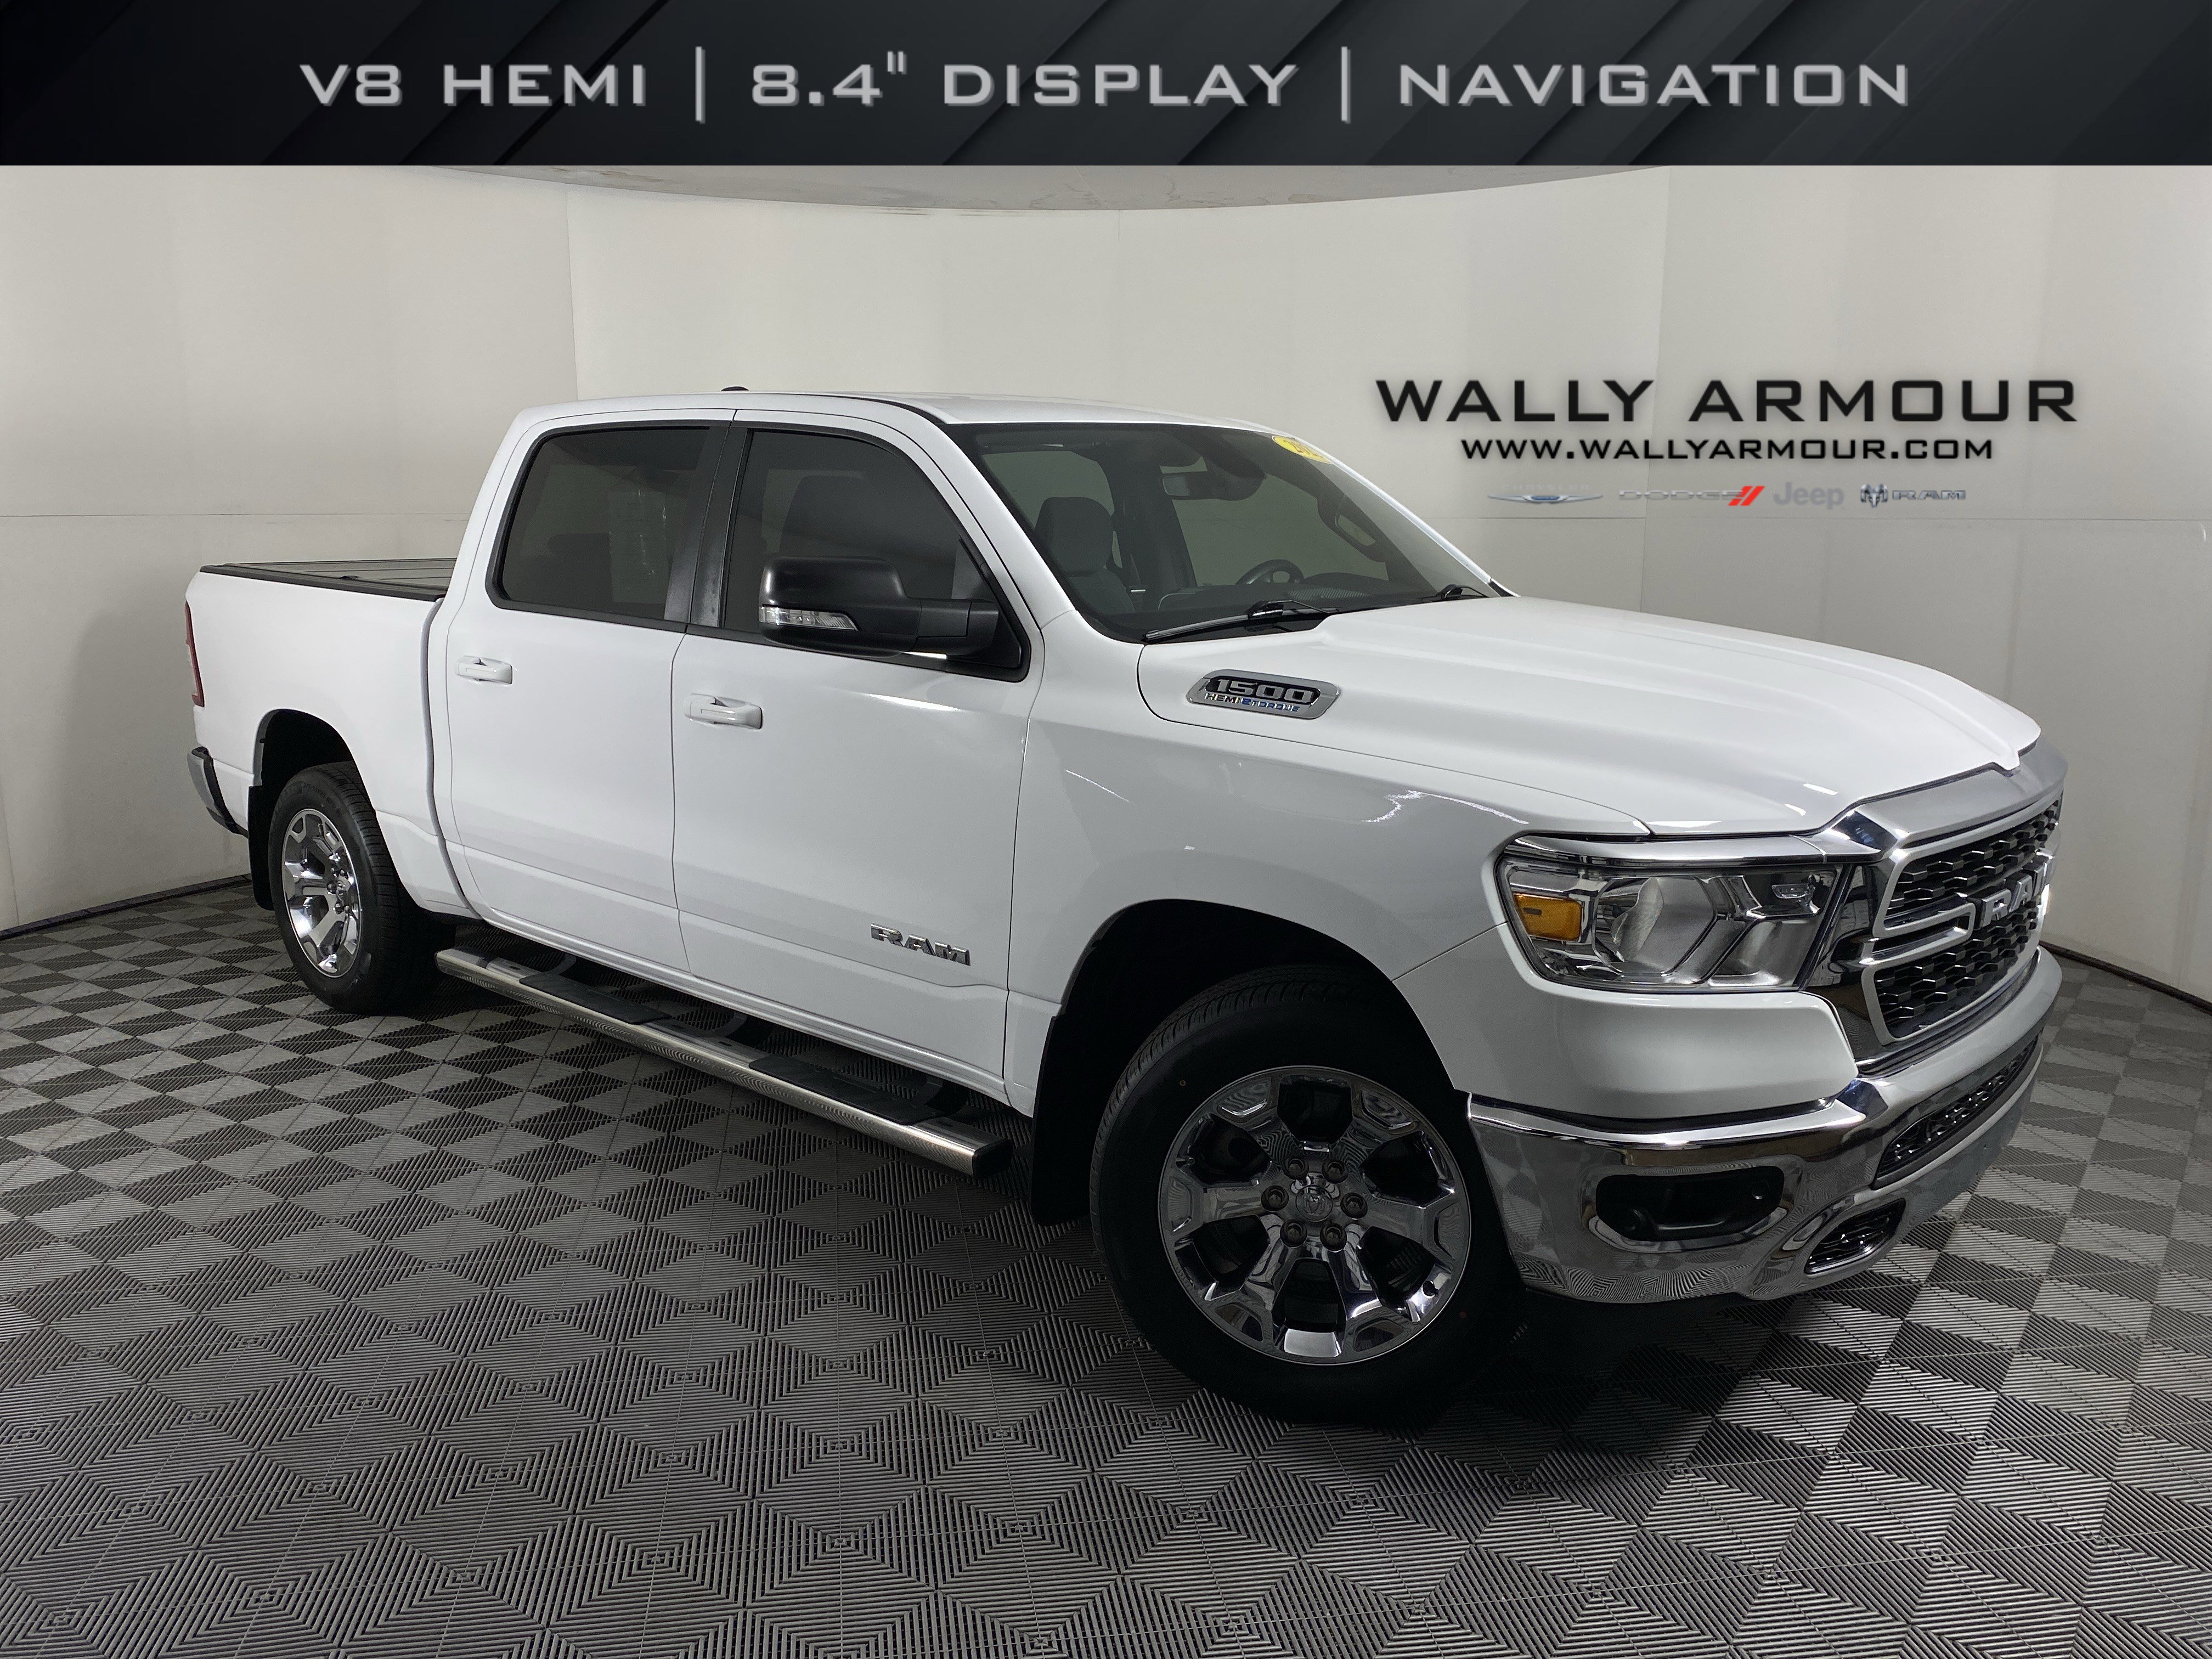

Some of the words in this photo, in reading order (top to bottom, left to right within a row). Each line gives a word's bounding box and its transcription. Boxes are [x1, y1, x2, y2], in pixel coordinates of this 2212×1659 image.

[1204, 692, 1239, 704] HEMI
[1217, 679, 1314, 704] 1500
[870, 923, 972, 967] RAM
